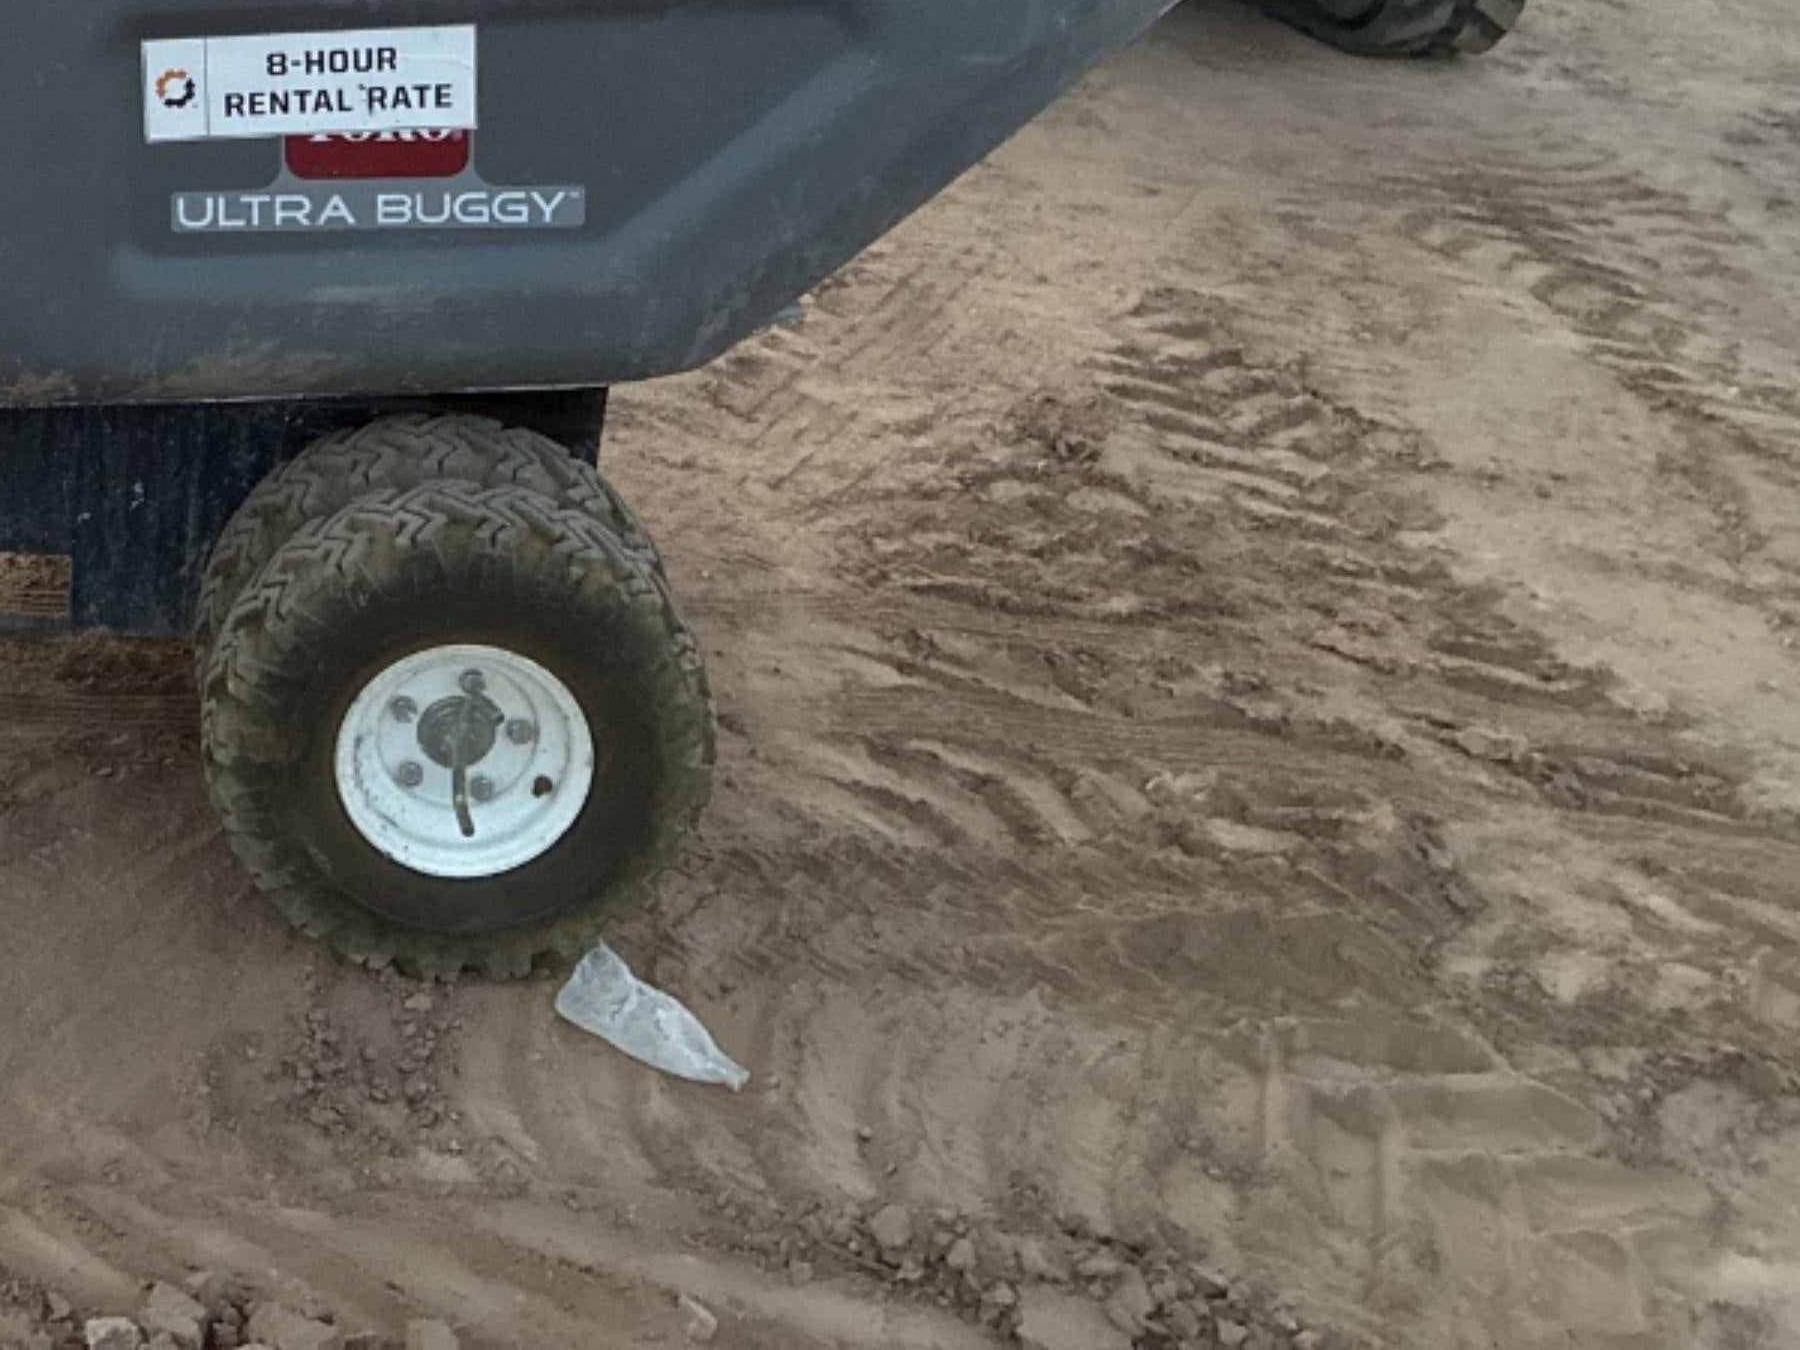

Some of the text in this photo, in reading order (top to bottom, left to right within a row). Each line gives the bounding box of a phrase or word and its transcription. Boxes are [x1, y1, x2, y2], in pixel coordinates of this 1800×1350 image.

[265, 47, 398, 77] 8-HOUR
[223, 83, 453, 118] RENTAL RATE
[176, 191, 566, 227] ULTRA BUGGY
